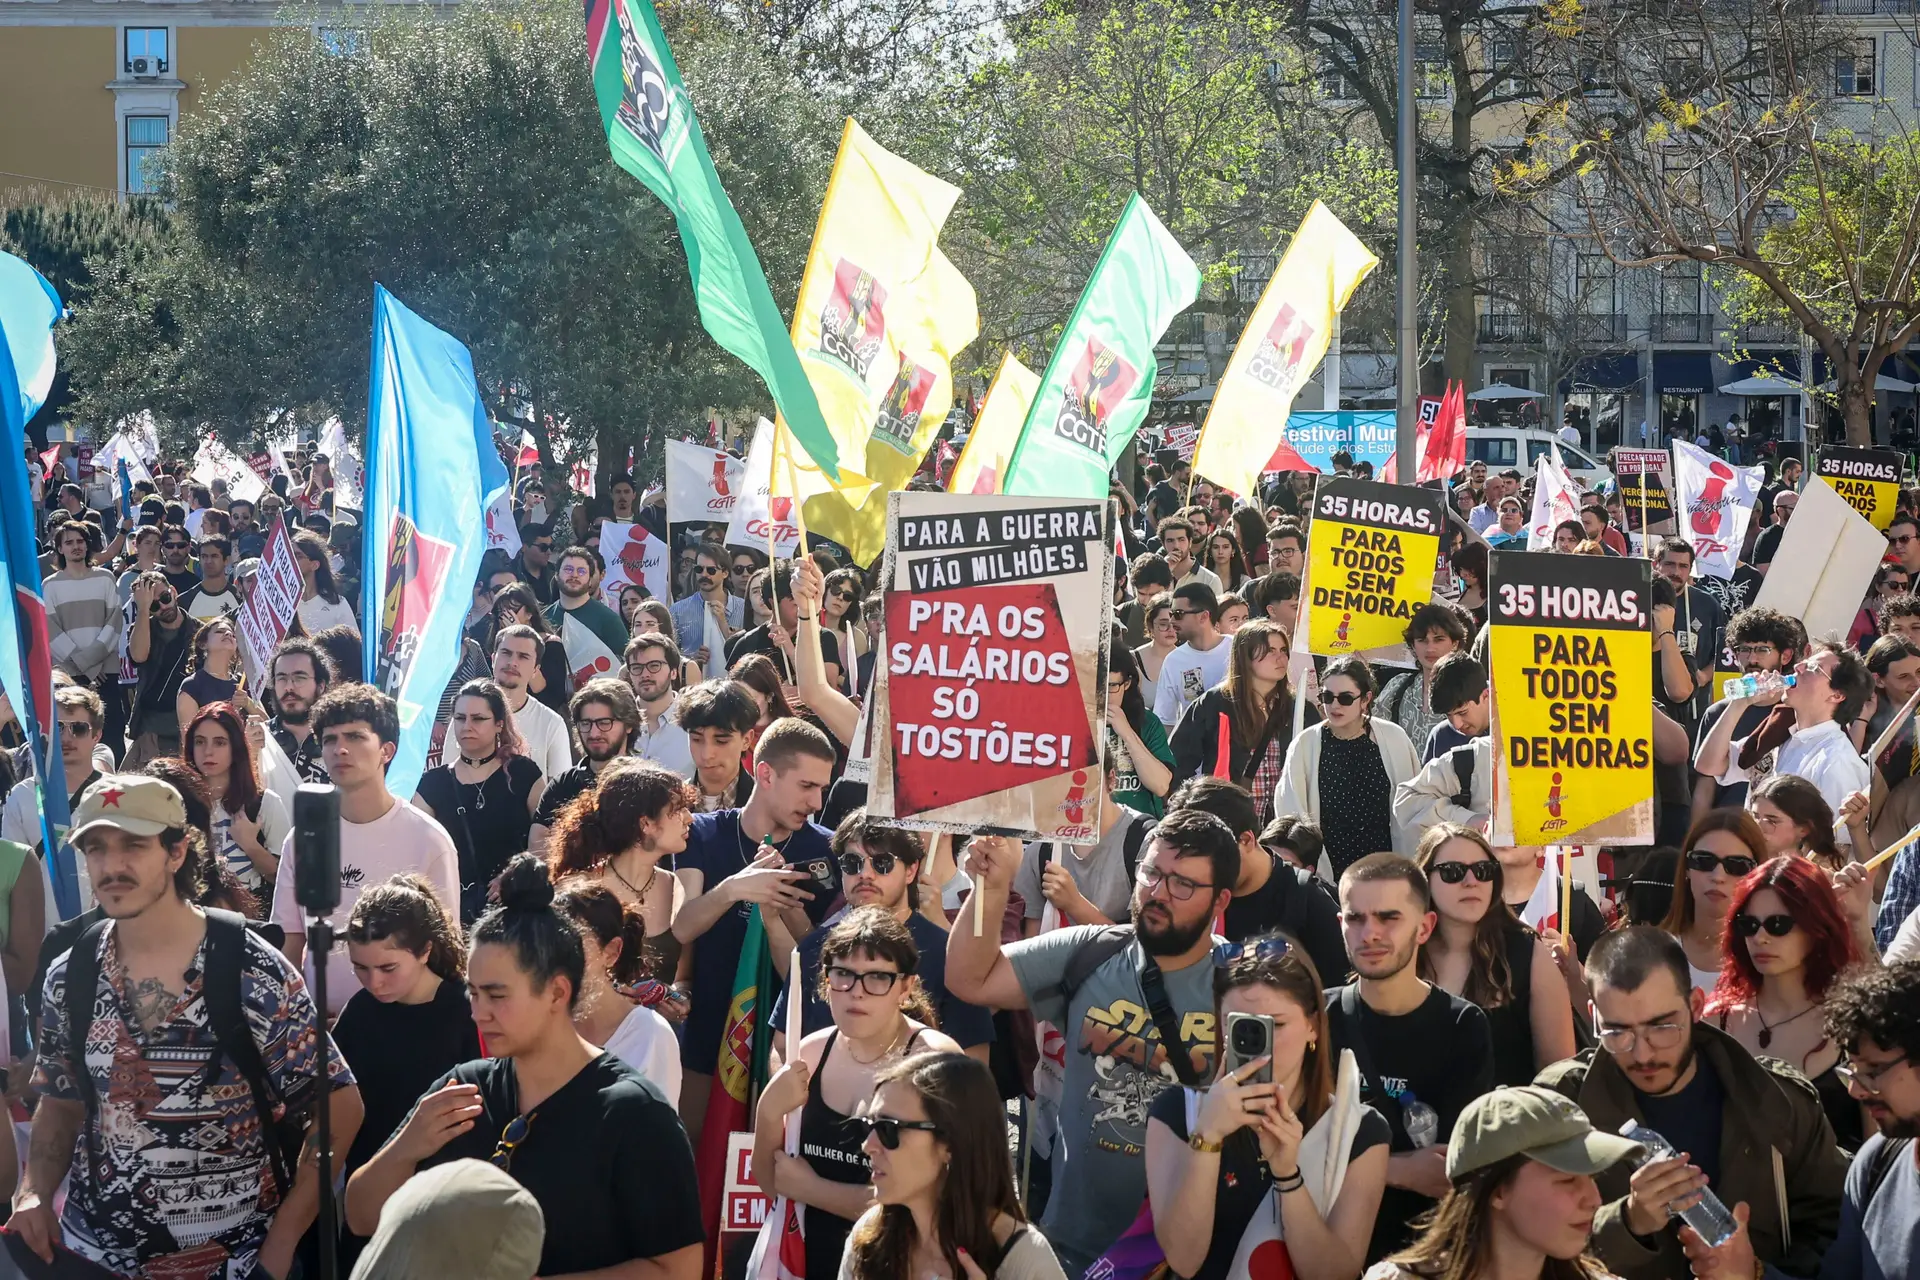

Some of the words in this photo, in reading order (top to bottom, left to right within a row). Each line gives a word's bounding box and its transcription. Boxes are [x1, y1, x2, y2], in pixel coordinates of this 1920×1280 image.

[822, 331, 867, 379] CGTP
[1248, 357, 1292, 393] CGTP
[1057, 412, 1107, 455] CGTP
[1629, 462, 1663, 473] PORUGAL
[1821, 458, 1841, 474] 35
[1842, 460, 1899, 482] HORAS,
[706, 495, 737, 510] CGTP
[1620, 487, 1667, 499] VERGNHA
[1626, 498, 1669, 510] NACONAL
[1835, 480, 1876, 498] PARA
[1841, 496, 1878, 512] DOS
[903, 518, 966, 548] PARA
[975, 516, 991, 542] A
[1001, 510, 1099, 542] GUERRA
[1319, 494, 1350, 518] 35
[1351, 498, 1437, 534] HORAS,
[745, 519, 800, 543] CGTP
[1340, 527, 1403, 556] PARA
[275, 534, 299, 601] TRABALHO
[913, 556, 962, 590] VÃO
[970, 543, 1086, 583] MILHÕES.
[1330, 546, 1406, 576] TODOS
[1345, 571, 1397, 597] SEM
[1499, 583, 1537, 618] 35
[1541, 586, 1647, 628] HORAS,
[997, 605, 1046, 640] OS
[889, 636, 1071, 685] SALÁRIOS
[1533, 634, 1612, 667] PARA
[931, 677, 980, 721] SÓ
[1521, 668, 1617, 701] TODOS
[1548, 702, 1611, 734] SEM
[896, 720, 1073, 769] TOSTÕES!
[1510, 736, 1650, 770] DEMORAS
[1055, 825, 1092, 839] CGTP
[1540, 818, 1568, 832] CGTP
[803, 1142, 844, 1163] MULHER
[845, 1152, 860, 1166] DE
